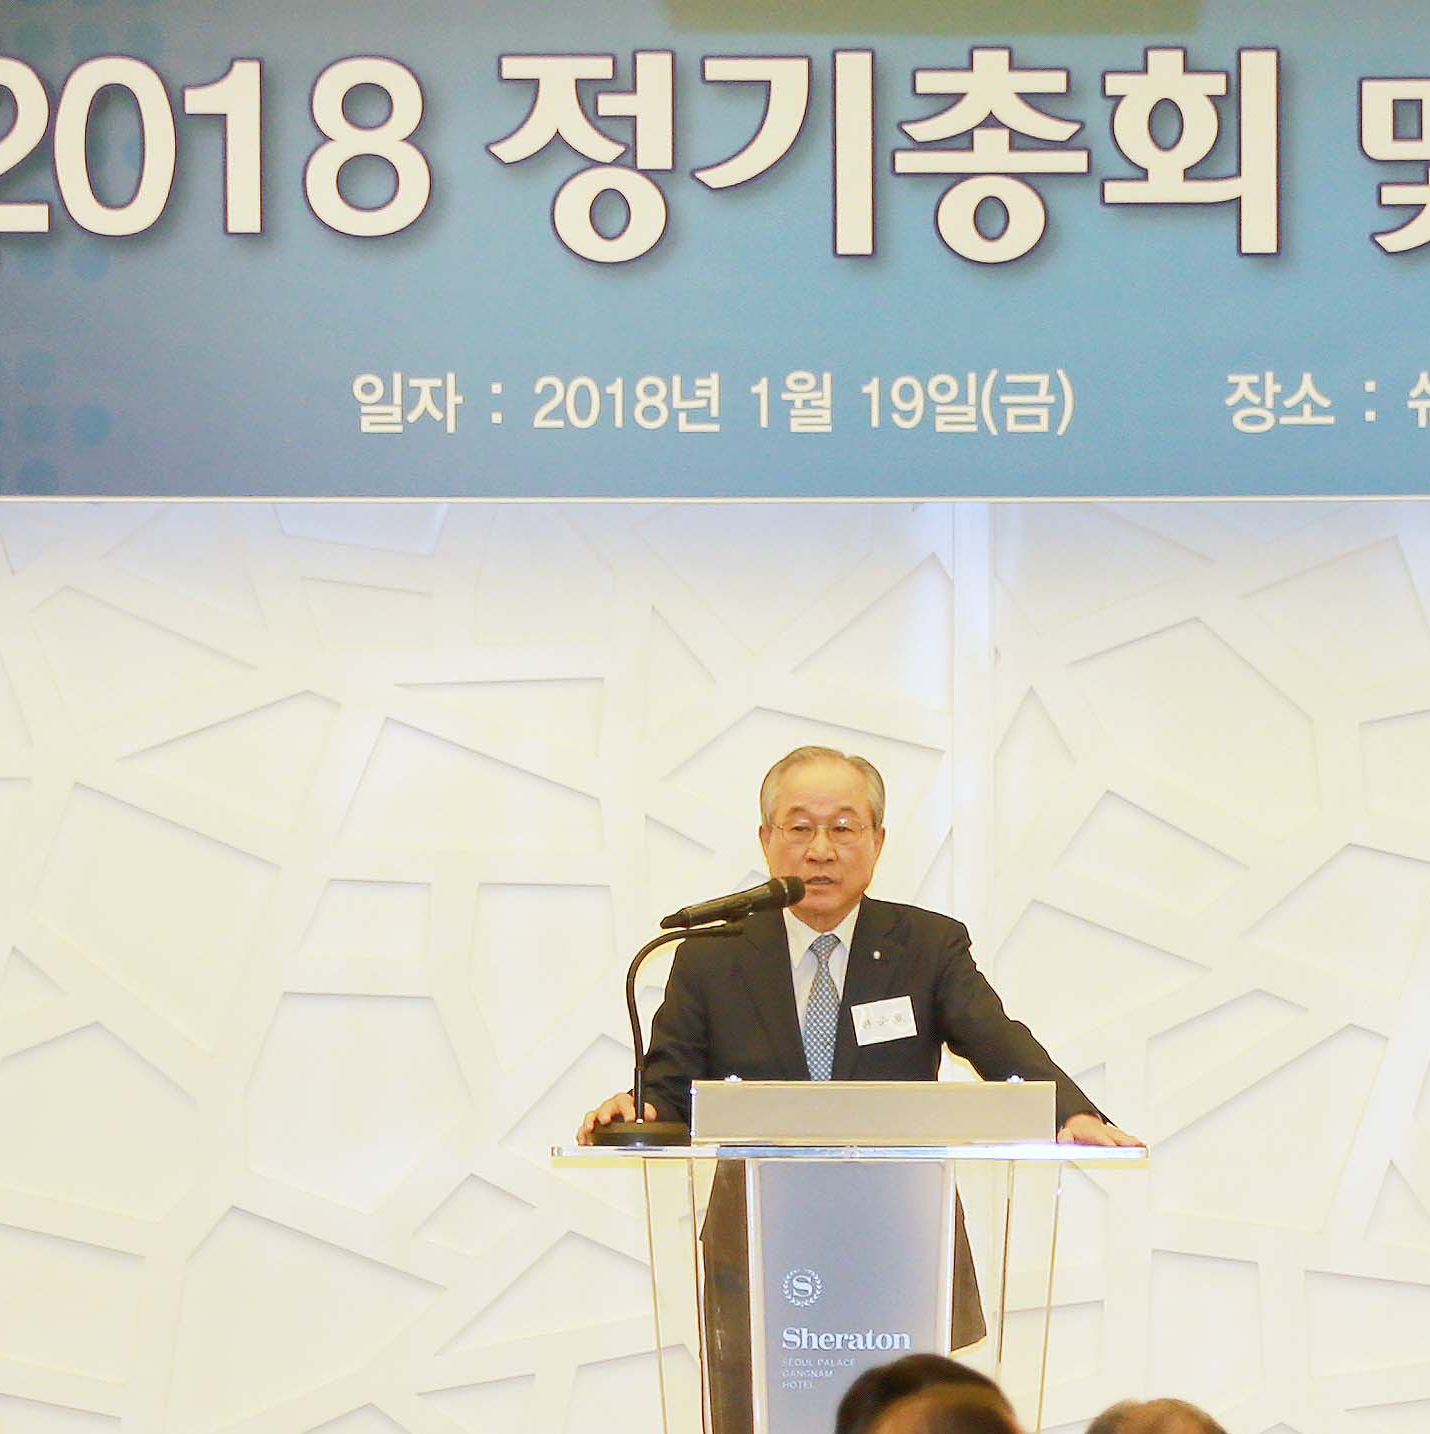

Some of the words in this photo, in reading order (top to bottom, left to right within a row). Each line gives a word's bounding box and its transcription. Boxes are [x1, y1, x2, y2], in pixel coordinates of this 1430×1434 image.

[489, 48, 1279, 265] 정기총회
[352, 372, 465, 433] 일자
[533, 372, 720, 433] 2018년
[751, 371, 832, 433] 1월
[862, 369, 1074, 435] 19일(금)
[1225, 371, 1336, 433] 장소
[781, 1326, 912, 1351] Sheraton
